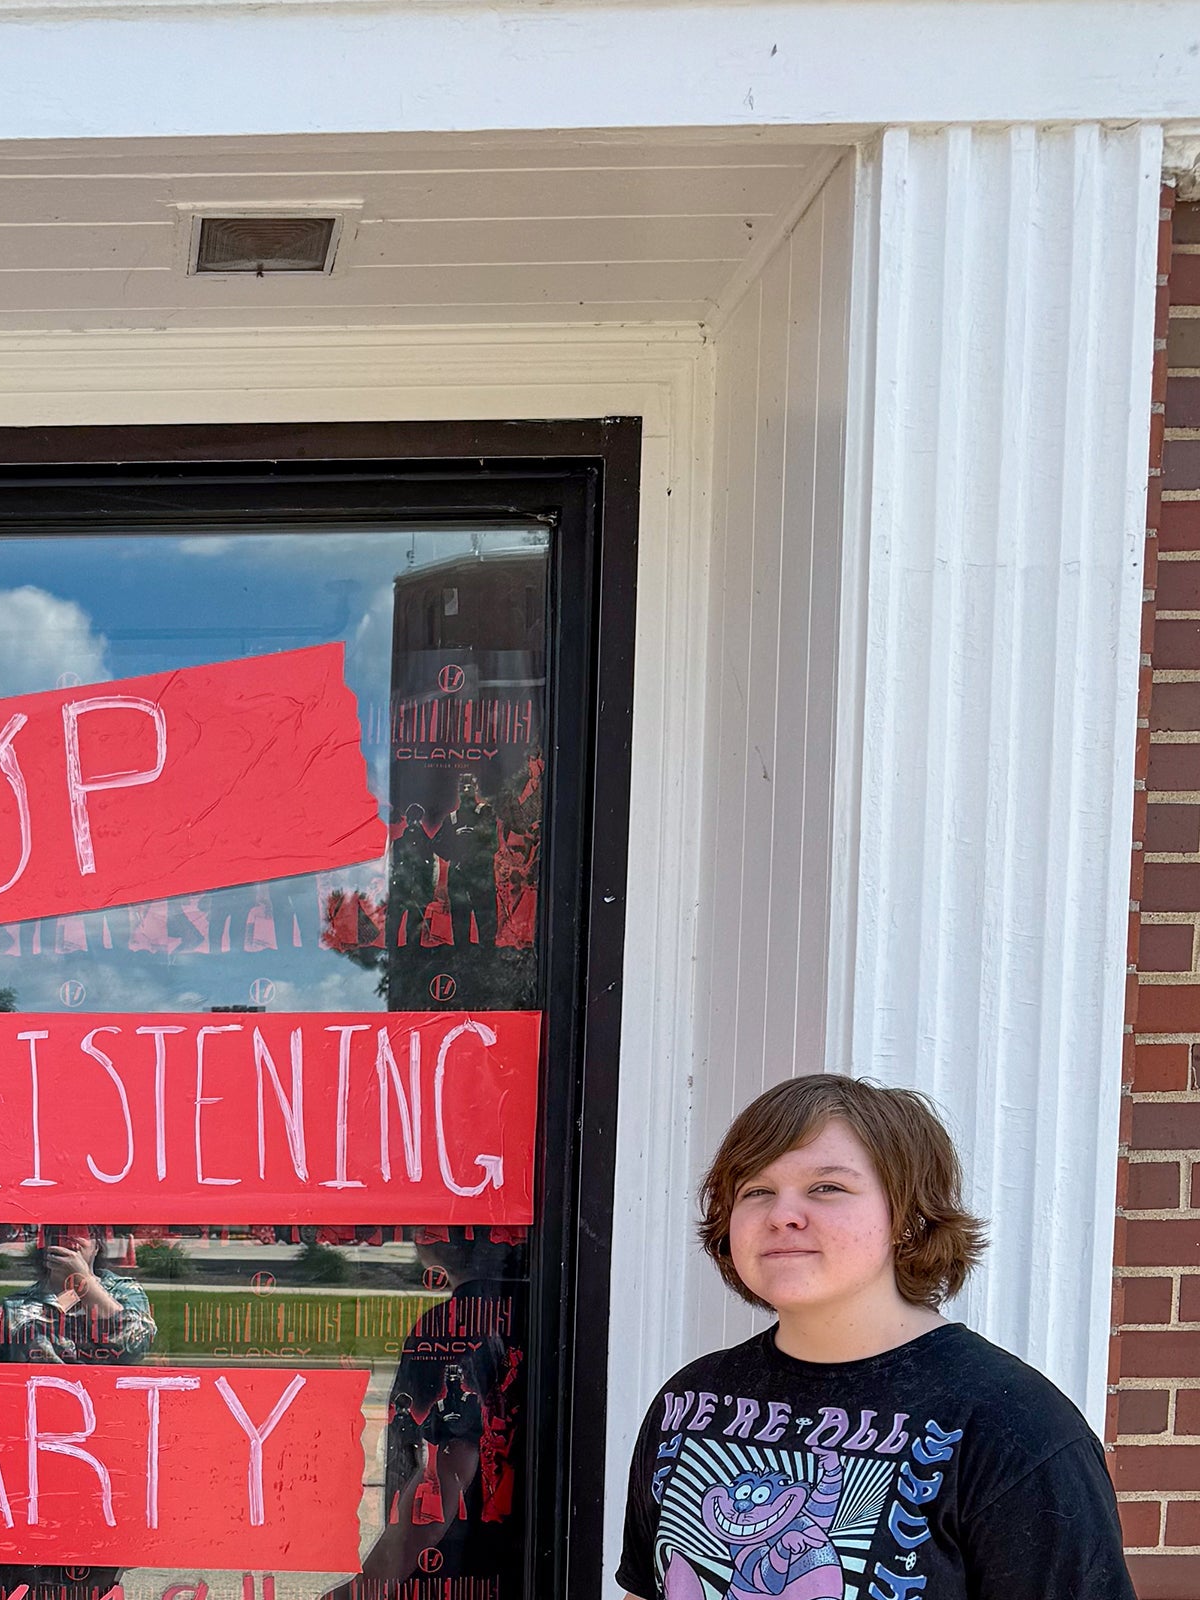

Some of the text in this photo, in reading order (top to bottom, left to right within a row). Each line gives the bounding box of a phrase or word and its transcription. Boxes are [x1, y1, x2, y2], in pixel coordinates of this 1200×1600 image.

[395, 747, 499, 761] CLANCY
[213, 1346, 312, 1359] CLANCY
[384, 1341, 483, 1353] CLANCY
[660, 1390, 911, 1455] WE'RE ALL
